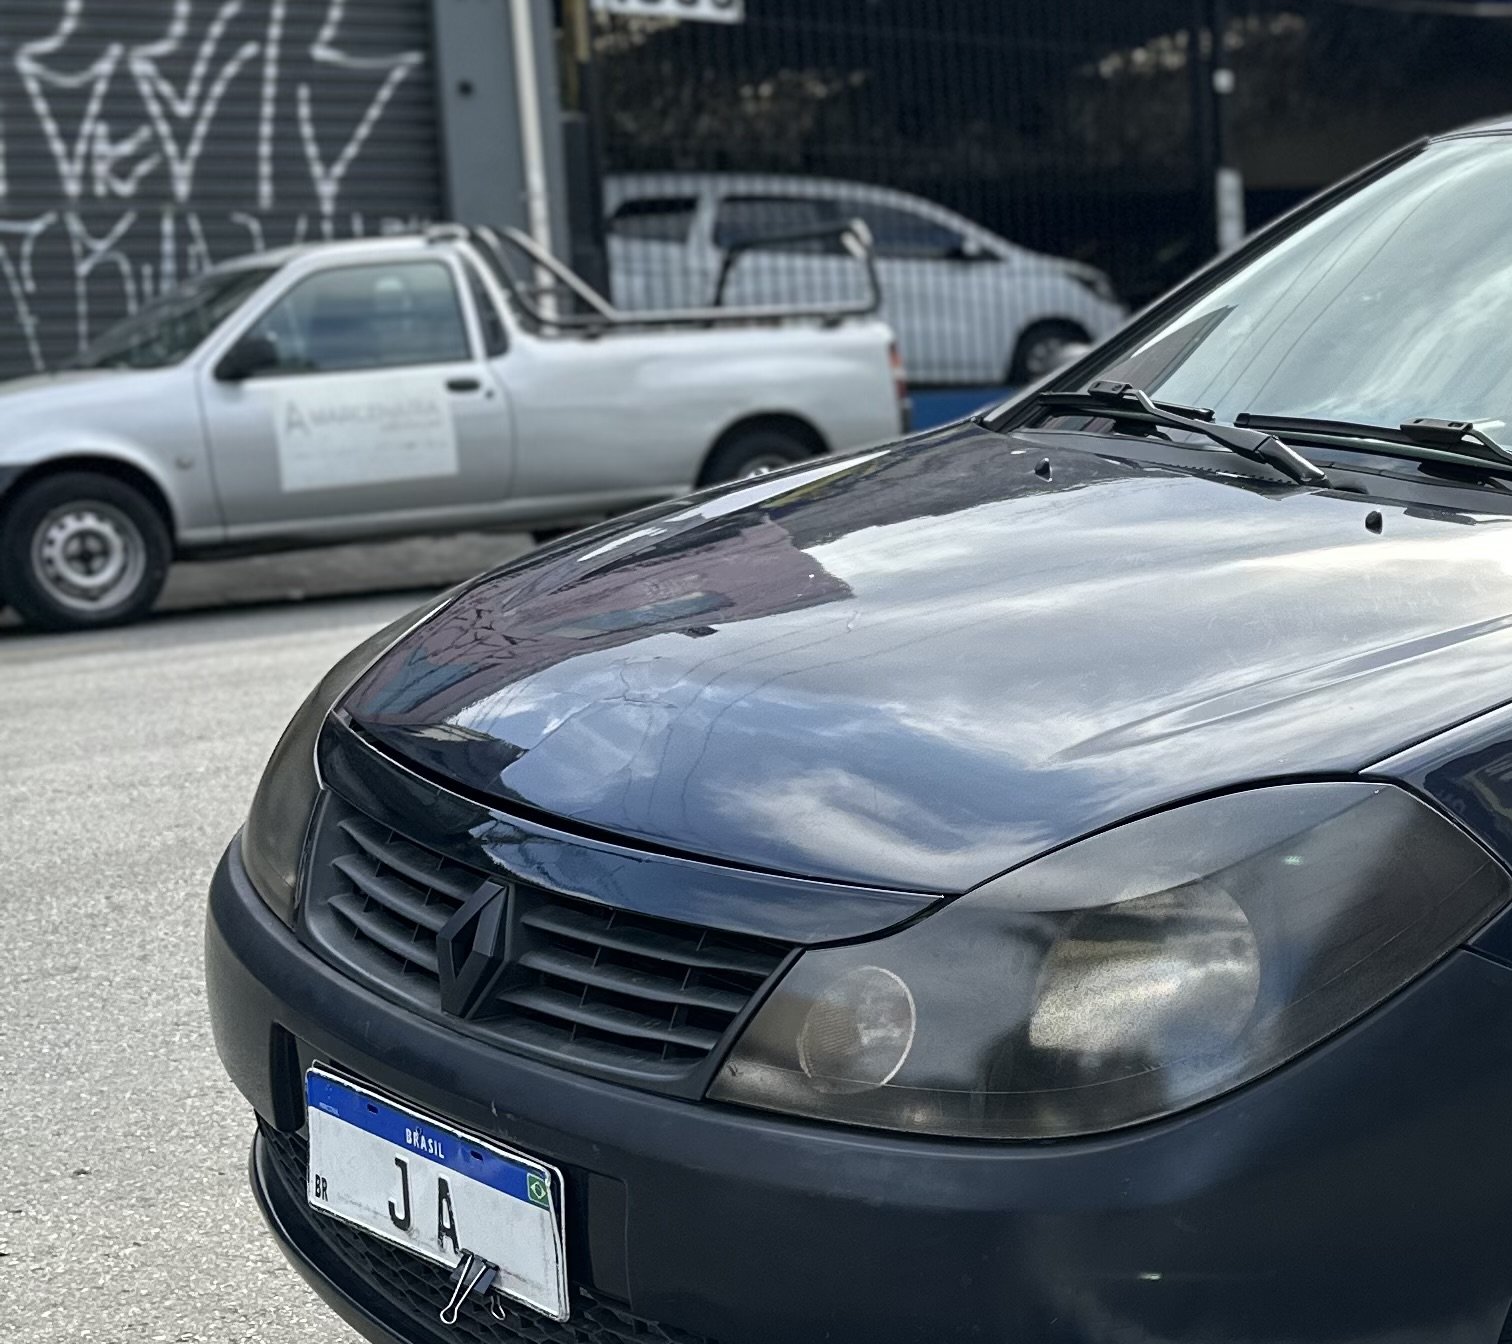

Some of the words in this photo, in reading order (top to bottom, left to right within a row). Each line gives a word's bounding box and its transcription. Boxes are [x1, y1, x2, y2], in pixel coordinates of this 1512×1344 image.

[404, 1125, 445, 1159] BRASIL
[314, 1173, 329, 1202] BR
[387, 1156, 412, 1232] J
[437, 1176, 461, 1255] A
